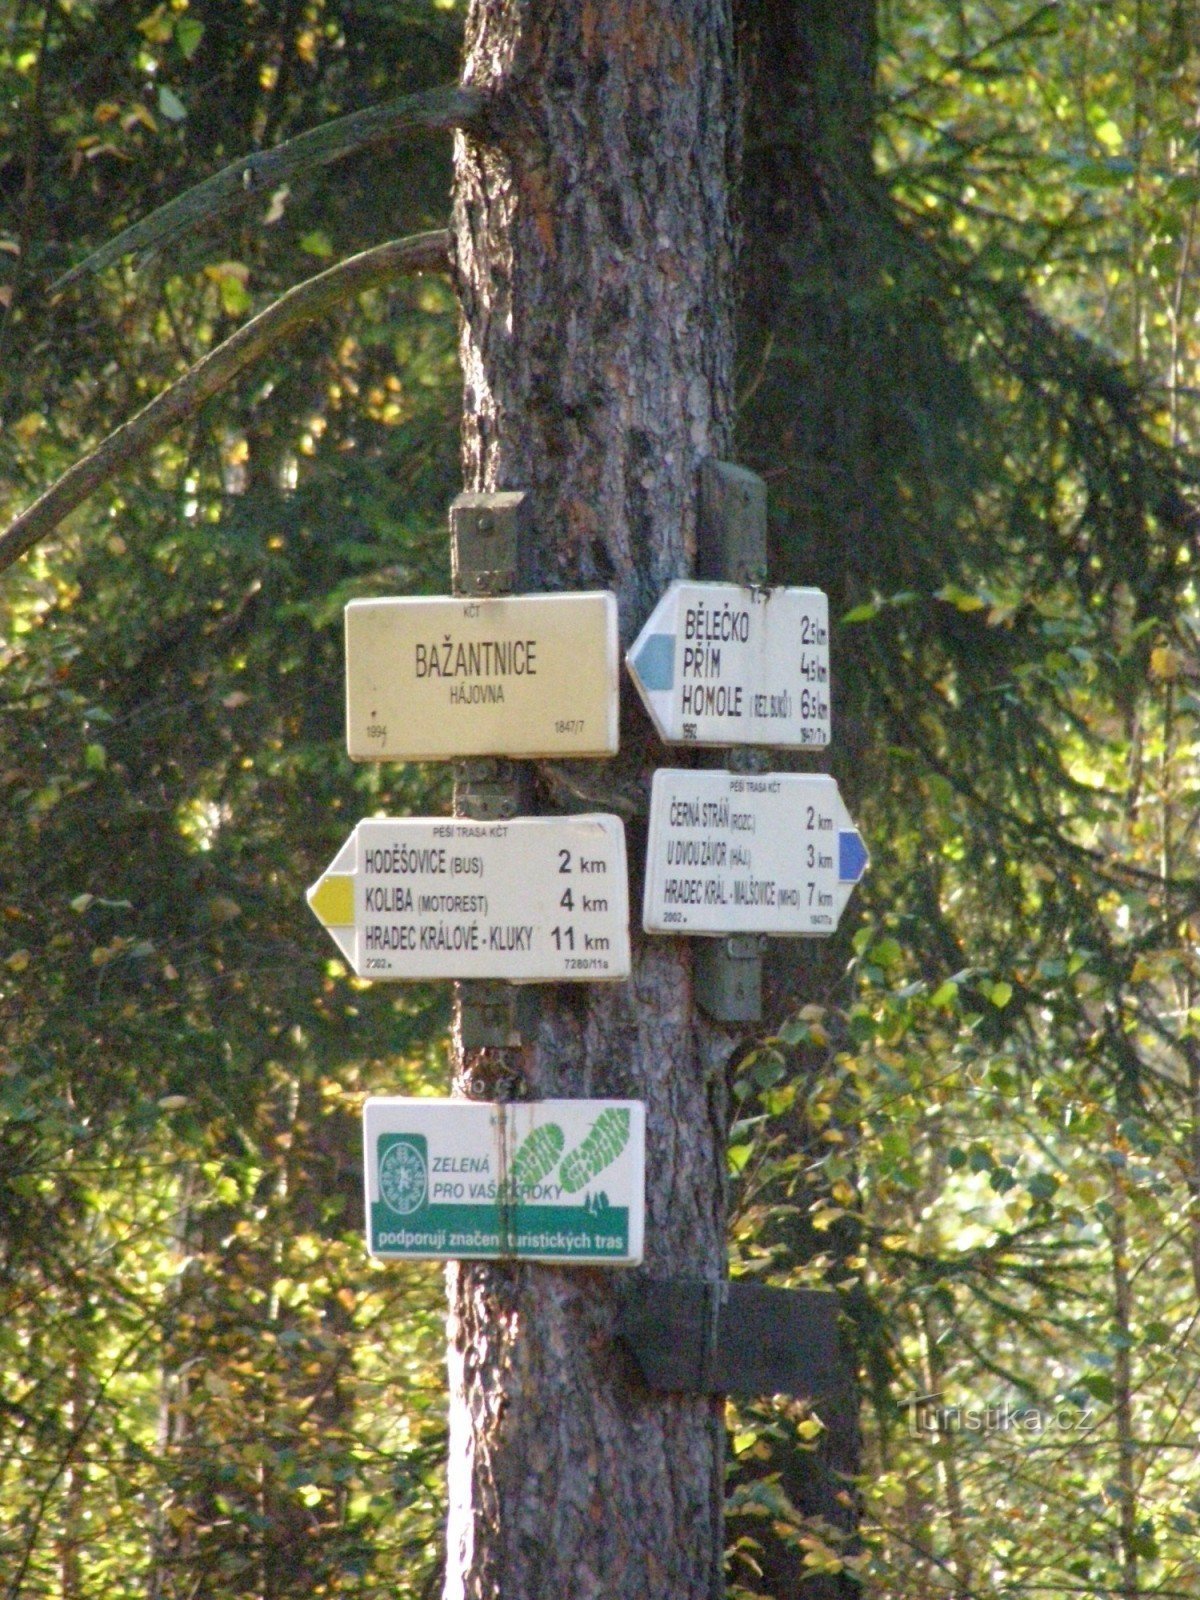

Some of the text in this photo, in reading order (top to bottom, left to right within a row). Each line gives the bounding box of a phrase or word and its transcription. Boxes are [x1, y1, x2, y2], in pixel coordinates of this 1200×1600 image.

[463, 603, 481, 619] KČT
[684, 601, 750, 643] BĚLEČKO
[415, 634, 537, 678] BAŽANTNICE
[682, 641, 721, 678] PŘÍM
[450, 682, 505, 704] HÁJOVNA
[681, 684, 743, 717] HOMOLE
[554, 719, 585, 735] 1847/7
[746, 781, 767, 793] TRASA
[768, 780, 782, 794] KČT
[670, 795, 700, 828] ČERNÁ
[805, 805, 815, 831] 2
[818, 813, 833, 831] km
[432, 824, 509, 838] PĚŠÍ TRASA KČT
[365, 843, 607, 878] HODĚŠOVICE (BUS) 2 km
[667, 840, 675, 866] U
[701, 835, 727, 867] ZÁVOR
[806, 844, 816, 869] 3
[818, 851, 833, 869] km
[365, 887, 608, 917] KOLIBA (MOTOREST) 4 km
[664, 878, 703, 905] HRADEC
[807, 881, 816, 907] 7
[818, 889, 834, 907] km
[365, 925, 417, 951] HRADEC
[420, 919, 479, 951] KRÁLOVÉ
[490, 925, 533, 951] KLUKY
[550, 926, 576, 951] 11
[584, 935, 610, 951] km
[431, 1154, 490, 1174] ZELENÁ
[432, 1182, 465, 1199] PRO
[378, 1229, 446, 1249] podporují
[449, 1229, 505, 1248] značen
[595, 1231, 624, 1249] tras
